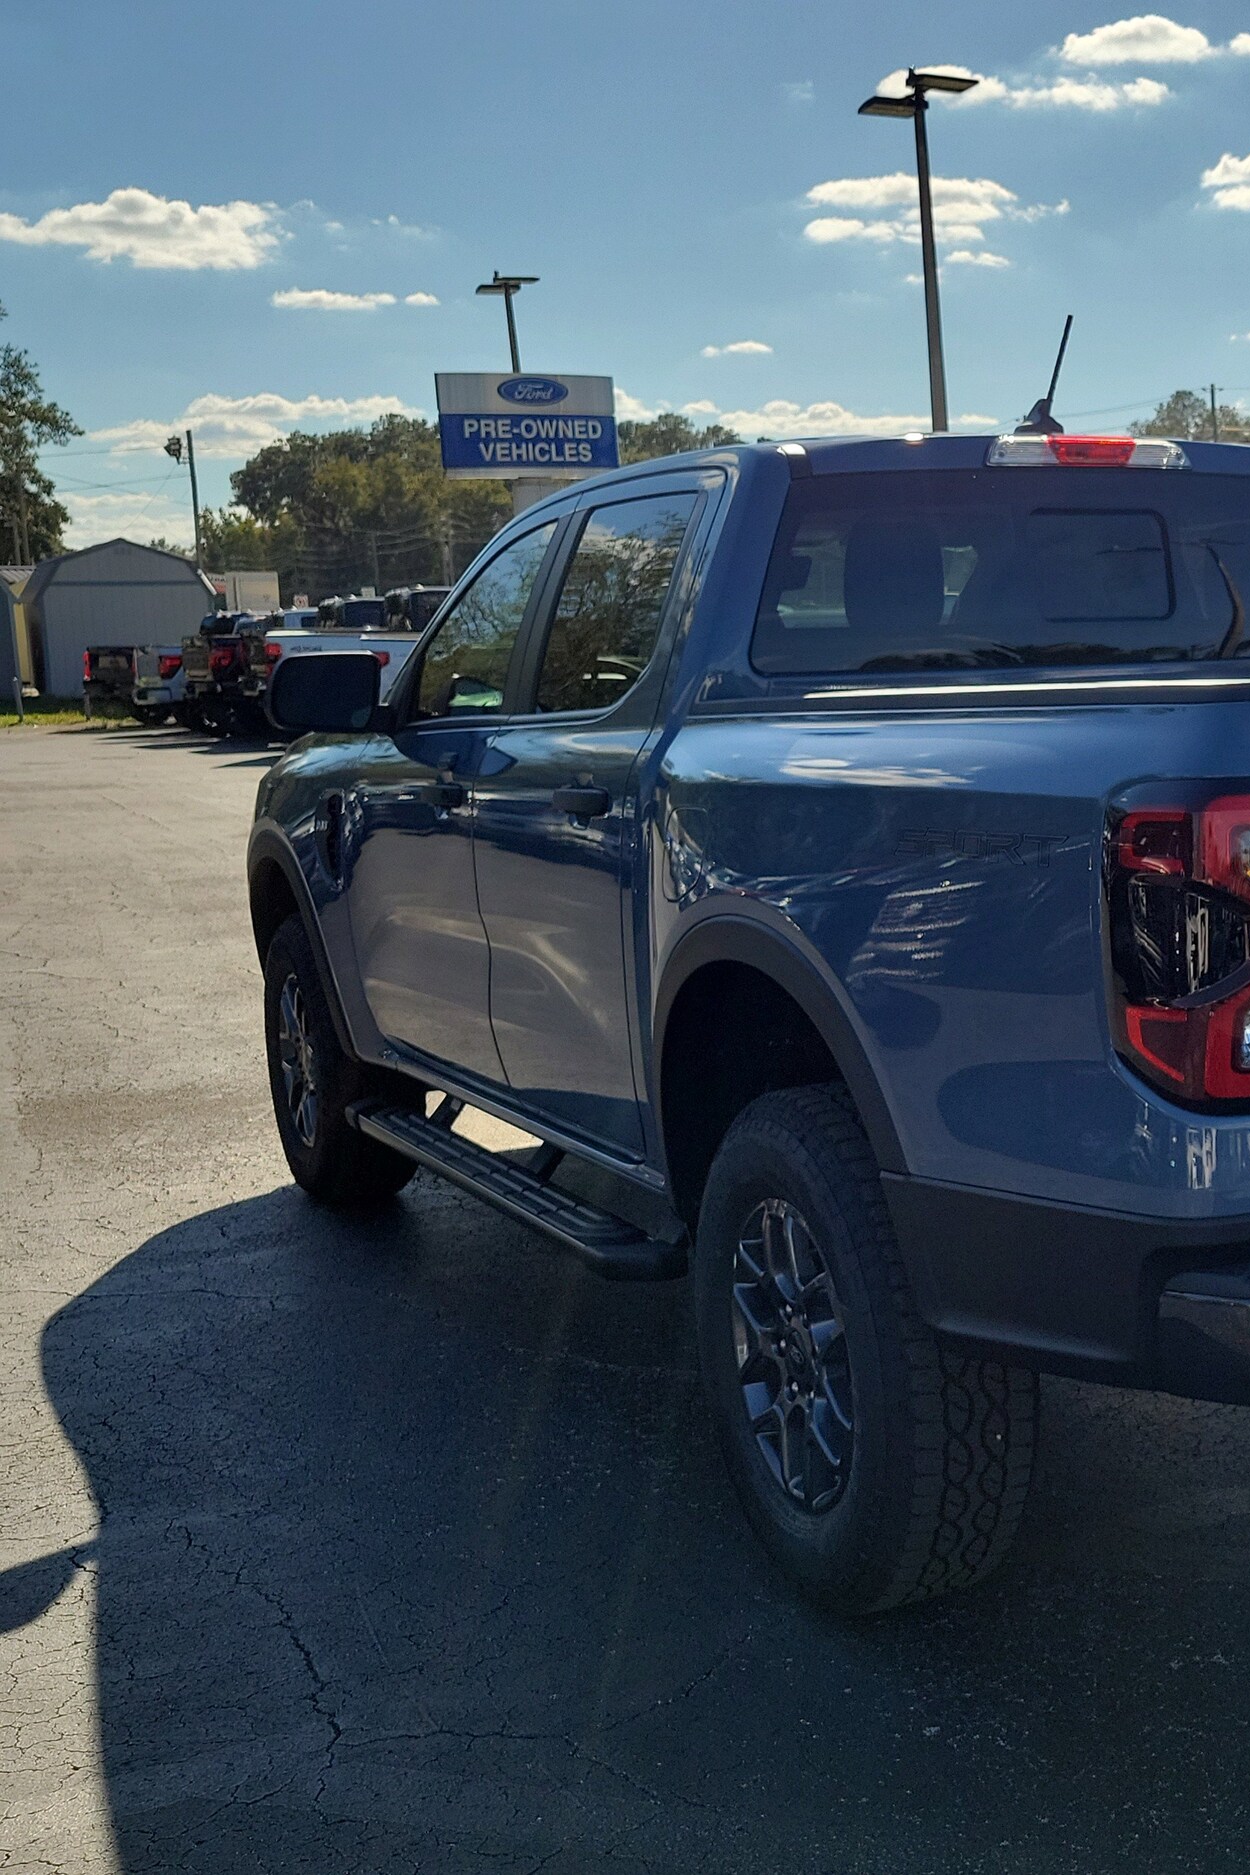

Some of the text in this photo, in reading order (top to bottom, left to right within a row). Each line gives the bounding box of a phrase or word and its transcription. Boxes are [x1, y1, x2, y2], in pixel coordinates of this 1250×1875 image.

[515, 383, 553, 400] Ford
[463, 418, 602, 440] PRE-OWNED
[479, 442, 592, 462] VEHICLES
[895, 827, 1069, 868] SPORT
